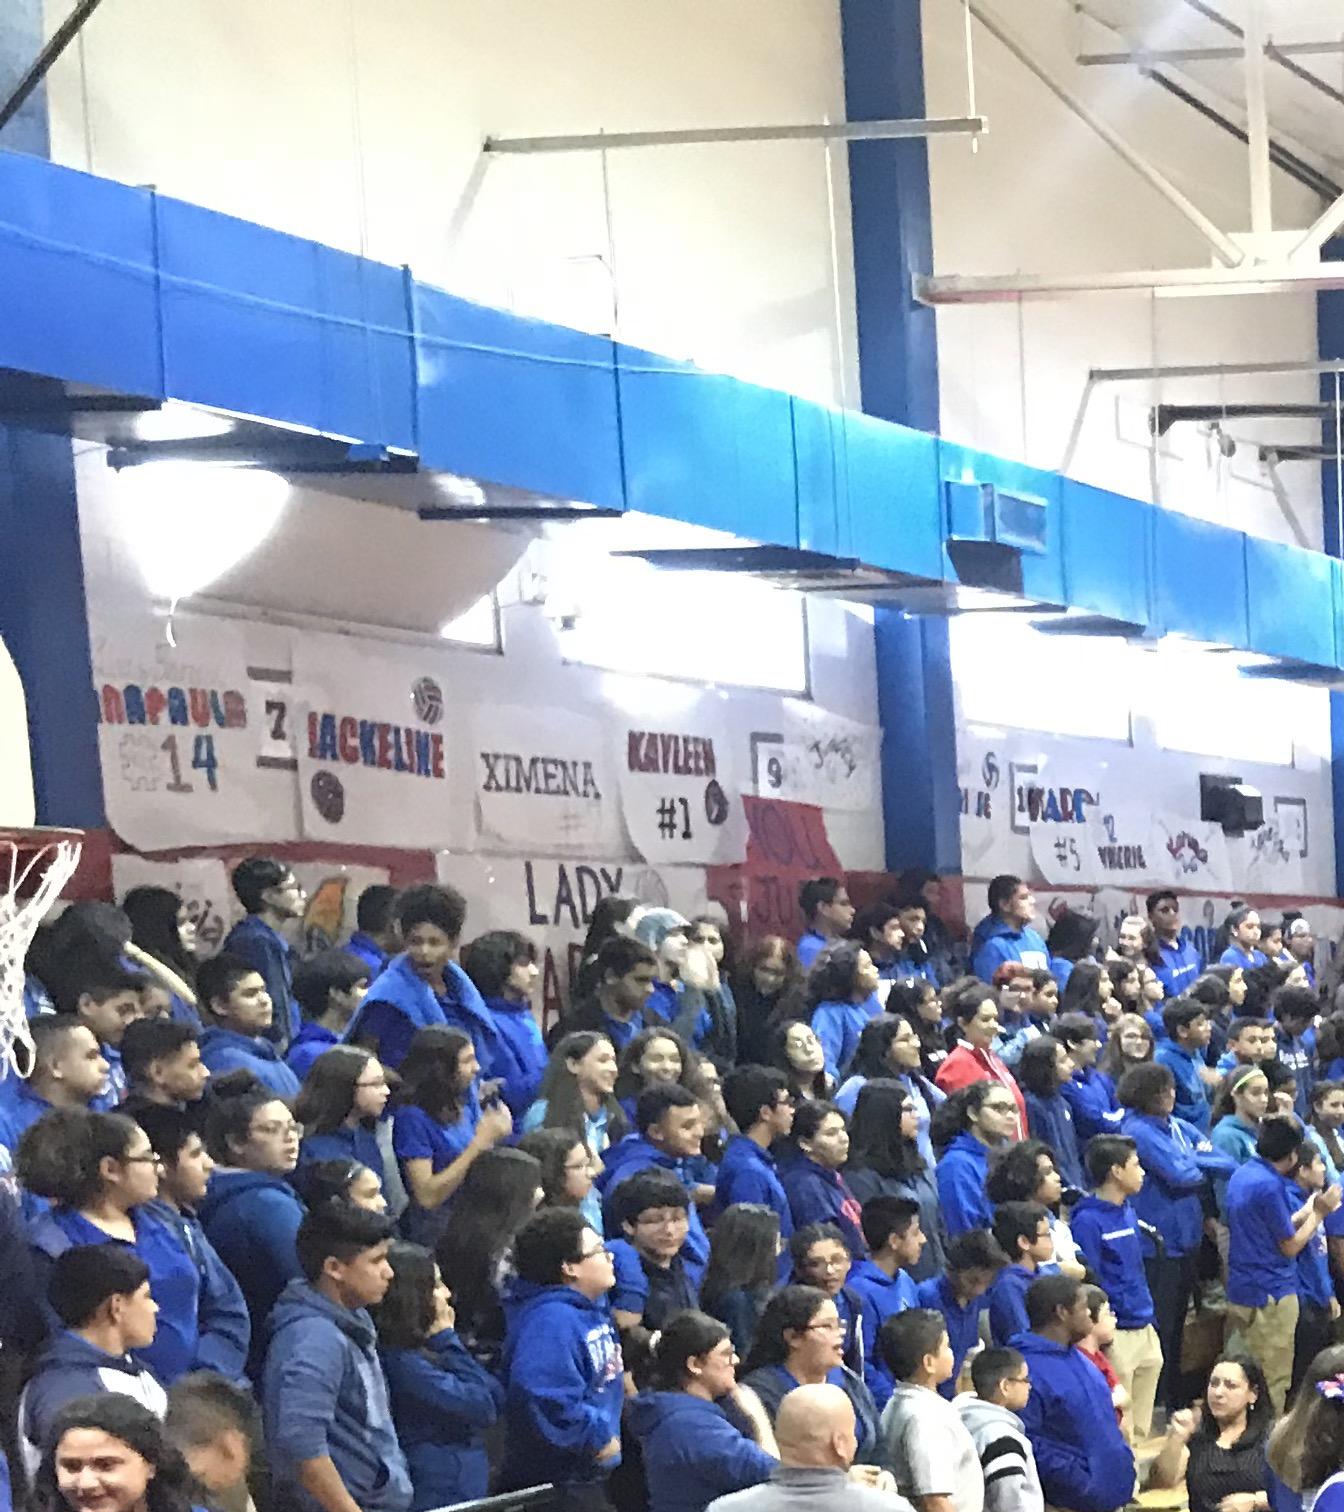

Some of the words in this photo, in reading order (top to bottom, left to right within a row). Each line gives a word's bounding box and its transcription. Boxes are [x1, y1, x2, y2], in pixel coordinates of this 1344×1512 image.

[480, 752, 602, 800] XIMENA
[656, 797, 692, 839] #1
[525, 861, 624, 929] LADY
